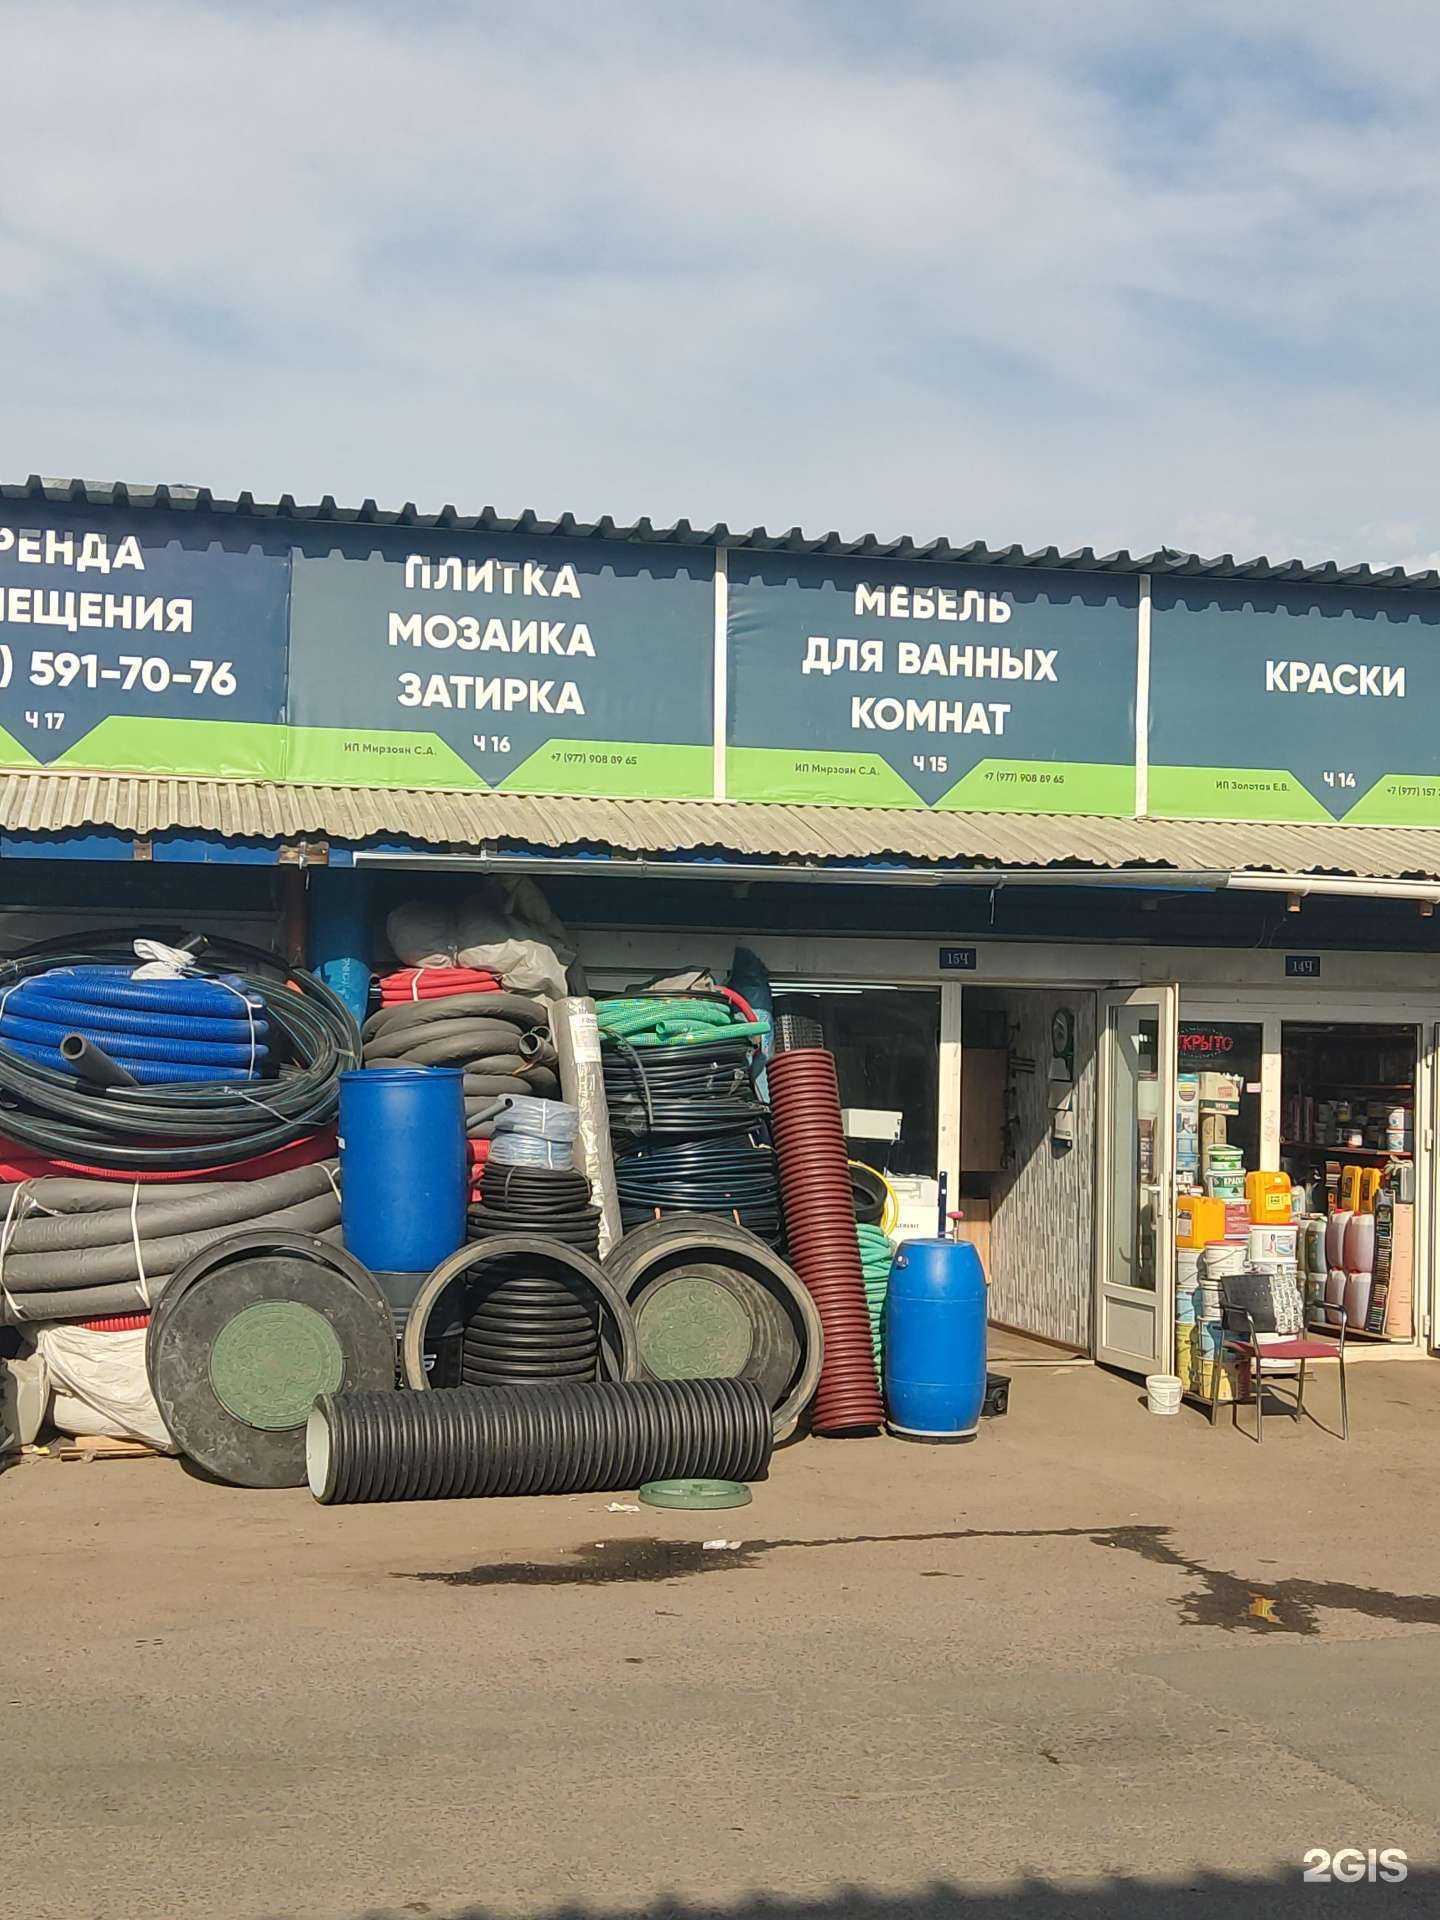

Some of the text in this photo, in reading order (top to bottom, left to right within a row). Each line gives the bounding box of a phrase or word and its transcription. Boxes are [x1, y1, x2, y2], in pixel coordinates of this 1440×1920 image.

[404, 554, 582, 599] ПЛИТКА
[0, 587, 193, 633] ЕЩЕНИЯ
[854, 582, 1013, 624] МЕБЕЛЬ
[387, 611, 598, 657] МОЗАИКА
[802, 636, 1059, 682] ДЛЯ ВАННЫХ
[29, 651, 238, 696] 591-70-76
[1265, 660, 1406, 698] КРАСКИ
[397, 672, 586, 716] ЗАТИРКА
[44, 712, 65, 730] 17
[851, 696, 1012, 736] КОМНАТ
[344, 743, 360, 752] ИП
[363, 744, 411, 755] Мирзоян
[491, 736, 511, 753] 16
[551, 753, 561, 762] +7
[563, 753, 586, 763] (977)
[589, 754, 608, 764] 908
[625, 756, 638, 765] 65
[929, 756, 948, 772] 15
[795, 763, 809, 772] ИП
[812, 764, 856, 775] Мирзоян
[984, 771, 1064, 784] +7 (977) 908 89 65
[1216, 780, 1229, 789] ИП
[1338, 772, 1356, 788] 14
[1387, 787, 1396, 796] +7
[1398, 786, 1419, 797] (977)
